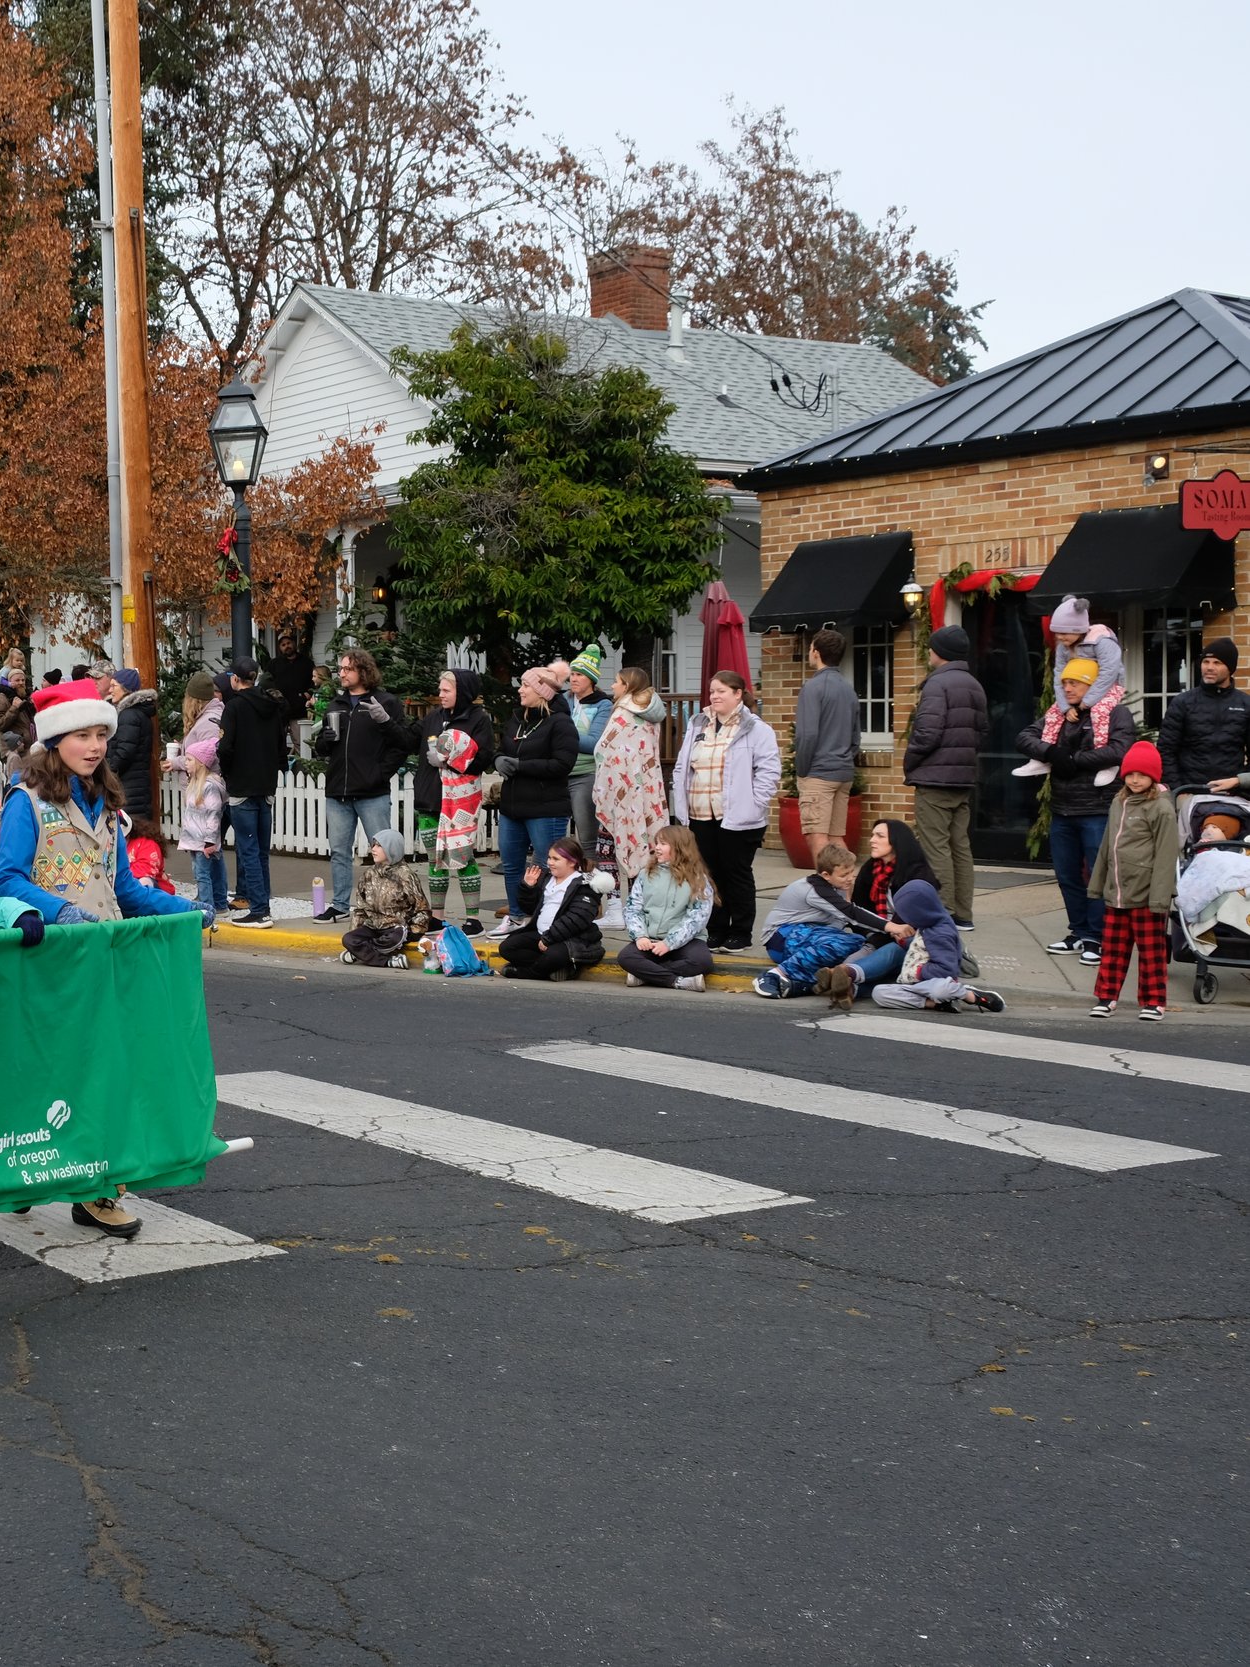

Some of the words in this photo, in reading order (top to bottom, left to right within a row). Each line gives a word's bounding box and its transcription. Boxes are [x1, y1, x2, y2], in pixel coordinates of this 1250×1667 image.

[1193, 489, 1247, 509] SOMA
[984, 546, 1010, 563] 255
[16, 1128, 51, 1146] scouts
[7, 1150, 17, 1168] of
[19, 1148, 60, 1166] oregon
[21, 1170, 34, 1185] &
[34, 1170, 50, 1183] sw
